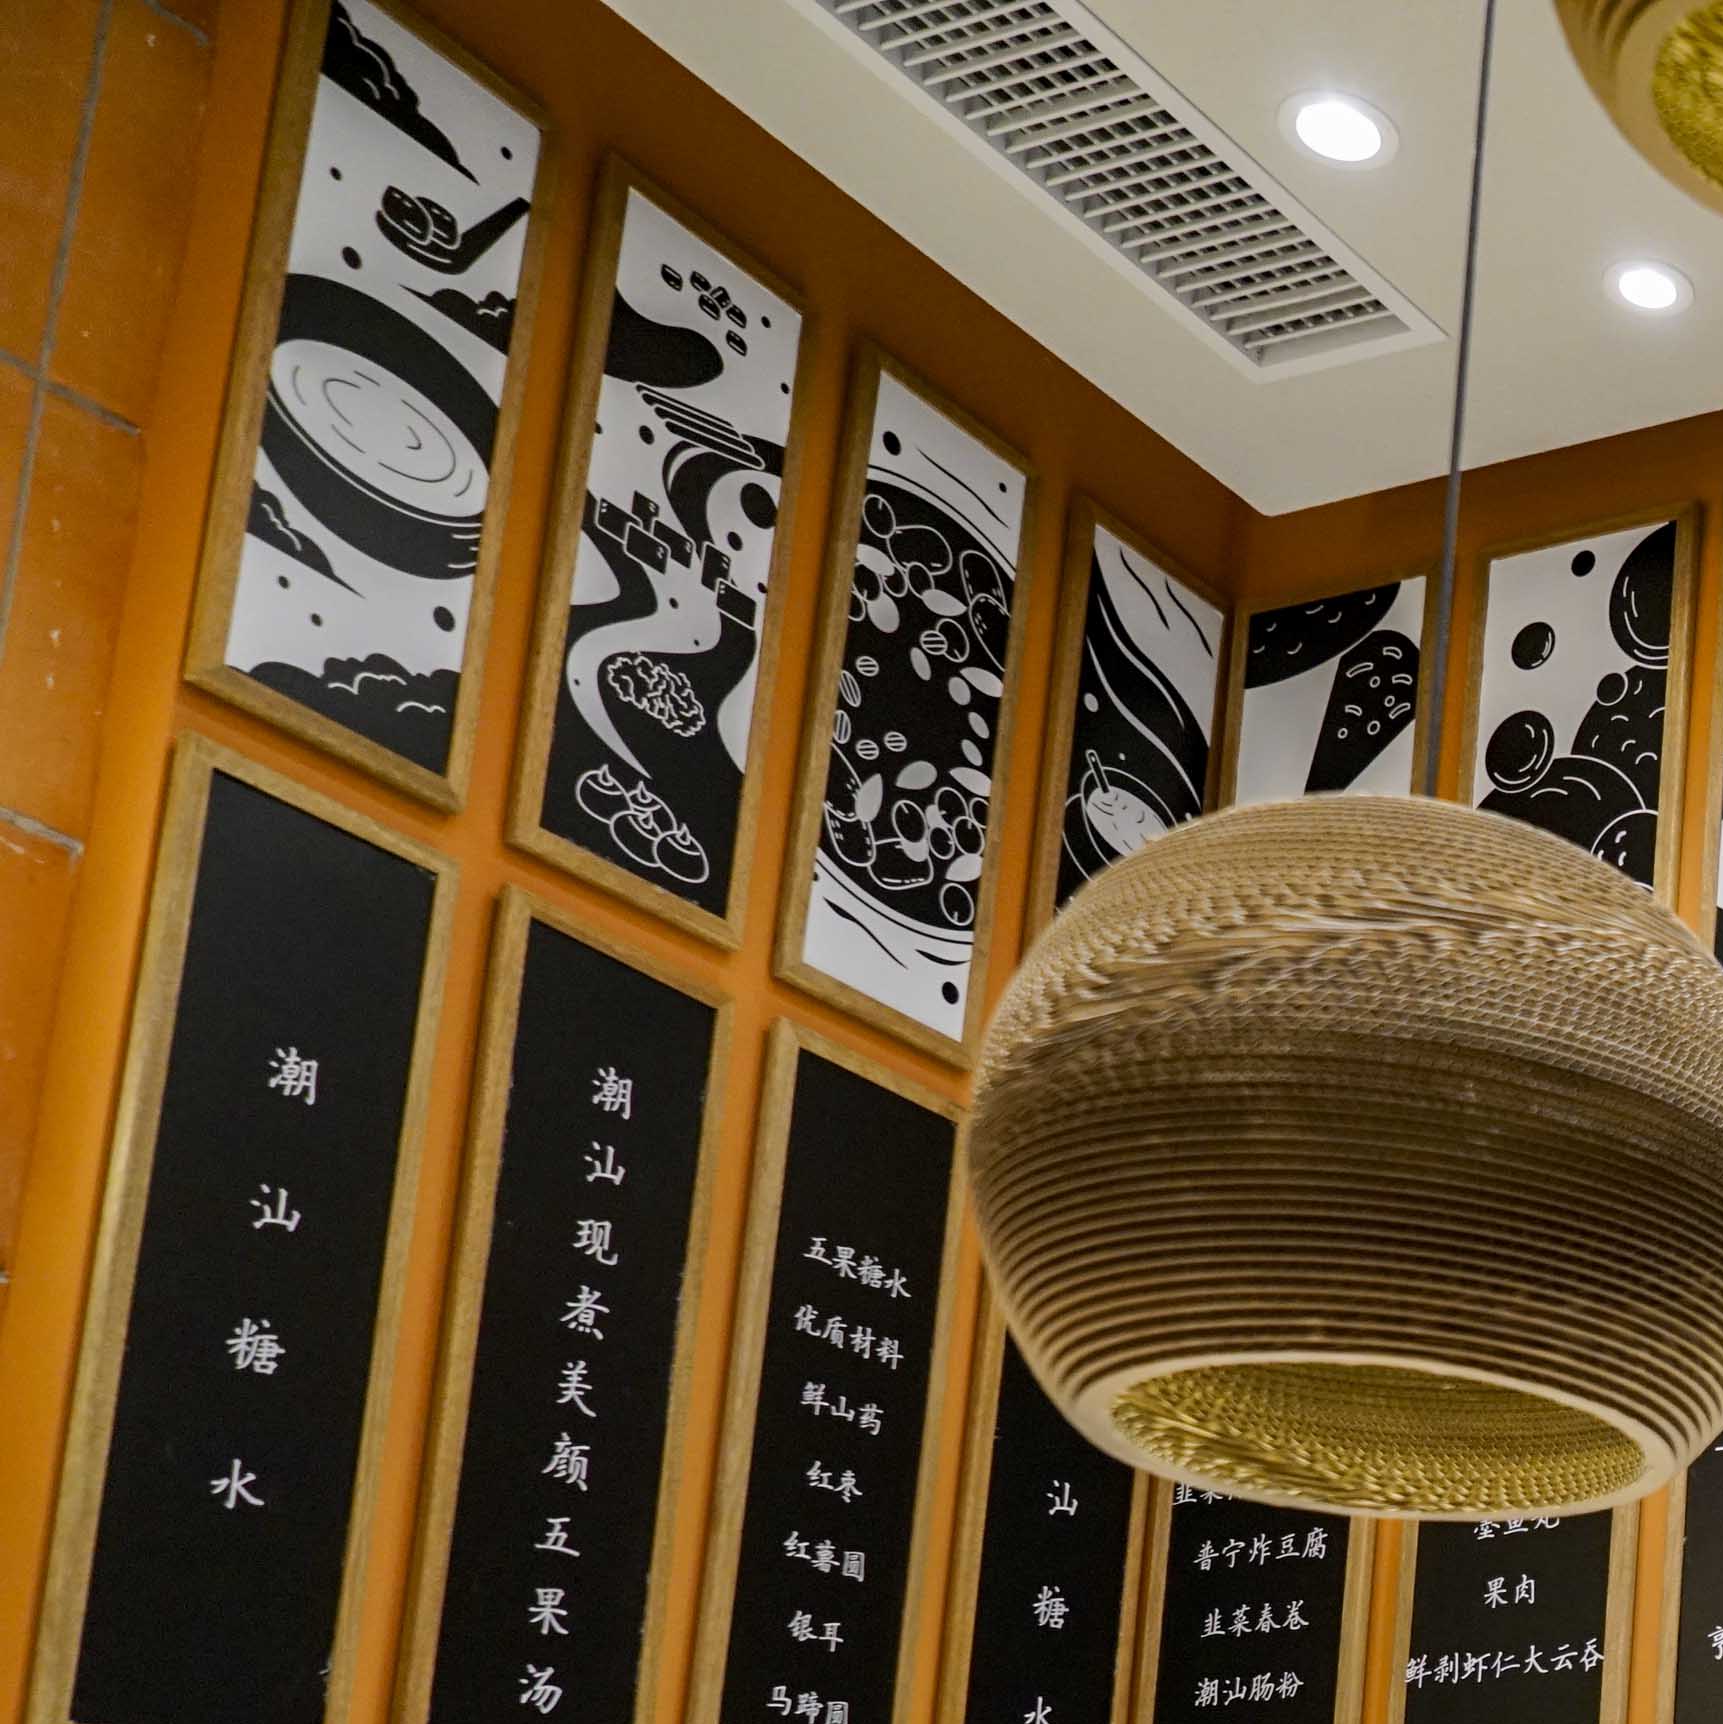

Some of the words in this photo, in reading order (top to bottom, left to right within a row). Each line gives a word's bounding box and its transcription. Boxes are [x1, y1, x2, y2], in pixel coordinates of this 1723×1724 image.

[210, 1046, 319, 1509] 潮汕糖水
[803, 1237, 912, 1298] 五果糖水
[794, 1304, 904, 1370] 优质材料
[518, 1065, 633, 1716] 潮汕现煮美颜五果汤
[800, 1381, 884, 1436] 鲜山药
[806, 1460, 863, 1503] 红枣
[783, 1530, 865, 1583] 红薯圆
[1193, 1526, 1328, 1571] 普宁炸豆腐
[1483, 1573, 1535, 1609] 果肉
[787, 1610, 844, 1653] 银耳
[1200, 1599, 1310, 1638] 韭菜春卷
[1404, 1637, 1605, 1686] 鲜剥虾仁大云吞
[1194, 1671, 1304, 1707] 潮汕肠粉
